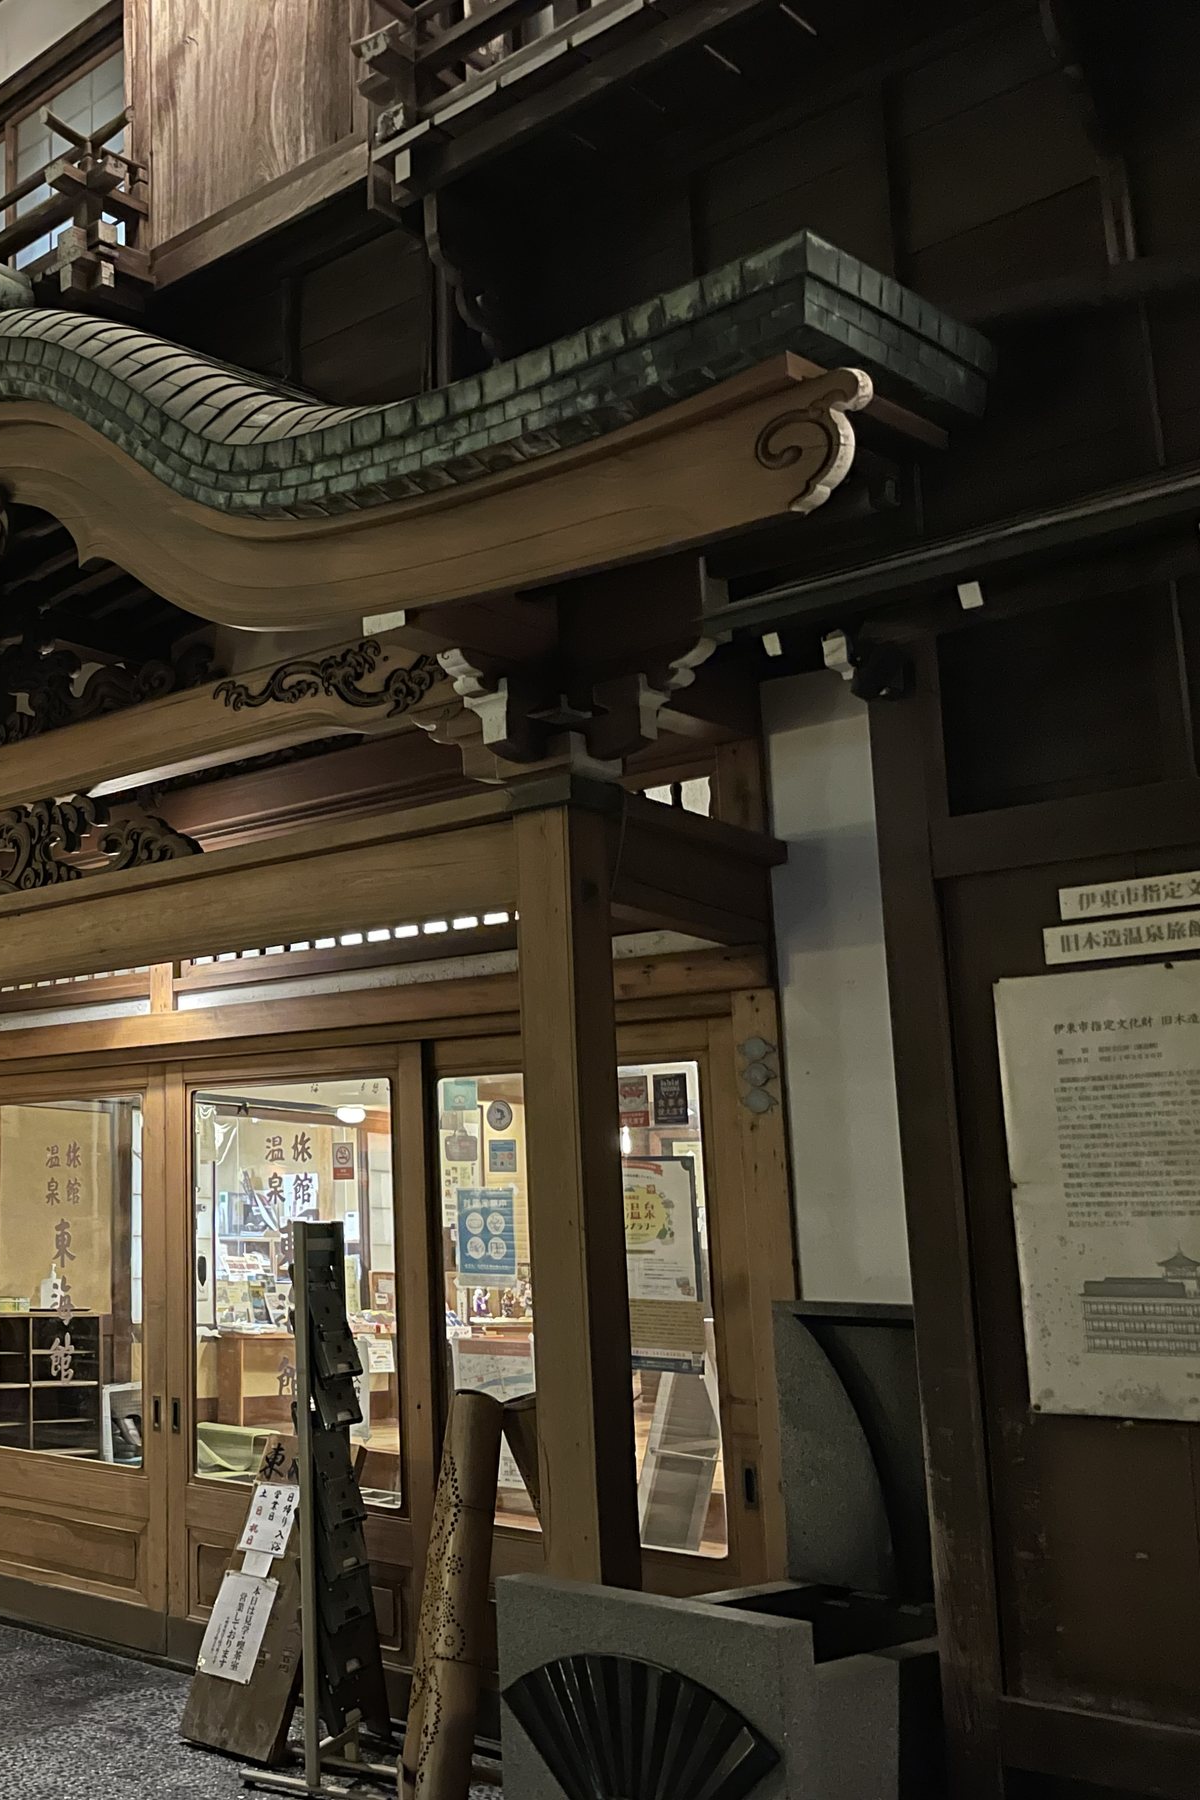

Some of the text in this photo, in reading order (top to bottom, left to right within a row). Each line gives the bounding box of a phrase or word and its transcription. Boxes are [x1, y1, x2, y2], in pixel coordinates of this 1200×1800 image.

[1053, 1015, 1153, 1036] 伊東市指定文化財
[45, 1144, 61, 1206] 温泉
[66, 1142, 82, 1206] 旅館
[265, 1136, 286, 1204] 温泉
[291, 1131, 314, 1204] 旅館
[49, 1218, 76, 1384] 東海館
[268, 1489, 282, 1521] 営業日
[270, 1492, 295, 1551] 日帰り入浴
[219, 1592, 248, 1669] 営業しております
